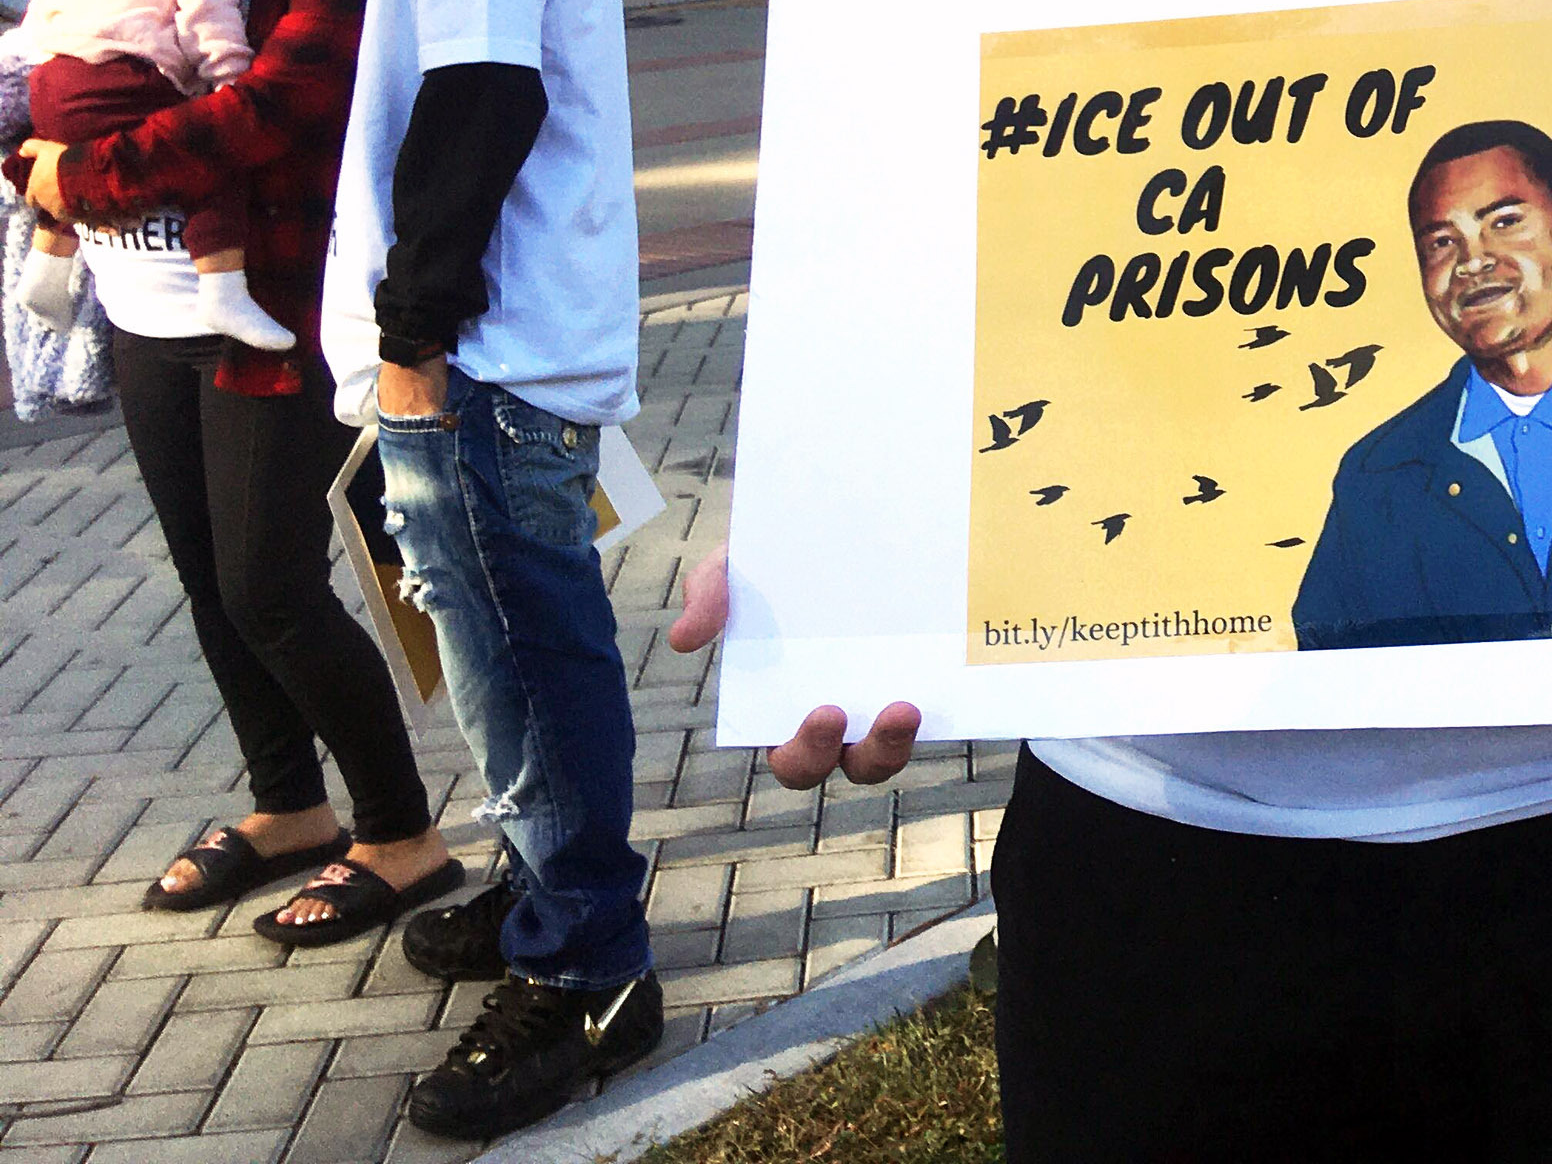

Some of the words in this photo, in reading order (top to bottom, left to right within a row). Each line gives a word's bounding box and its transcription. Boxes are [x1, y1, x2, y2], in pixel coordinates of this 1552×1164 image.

[981, 87, 1162, 159] #ICE
[1181, 72, 1328, 150] OUT
[1345, 65, 1436, 138] OF
[1136, 165, 1226, 235] CA
[1061, 238, 1376, 327] PRISONS
[984, 610, 1272, 650] bit.ly/keeptithhome
